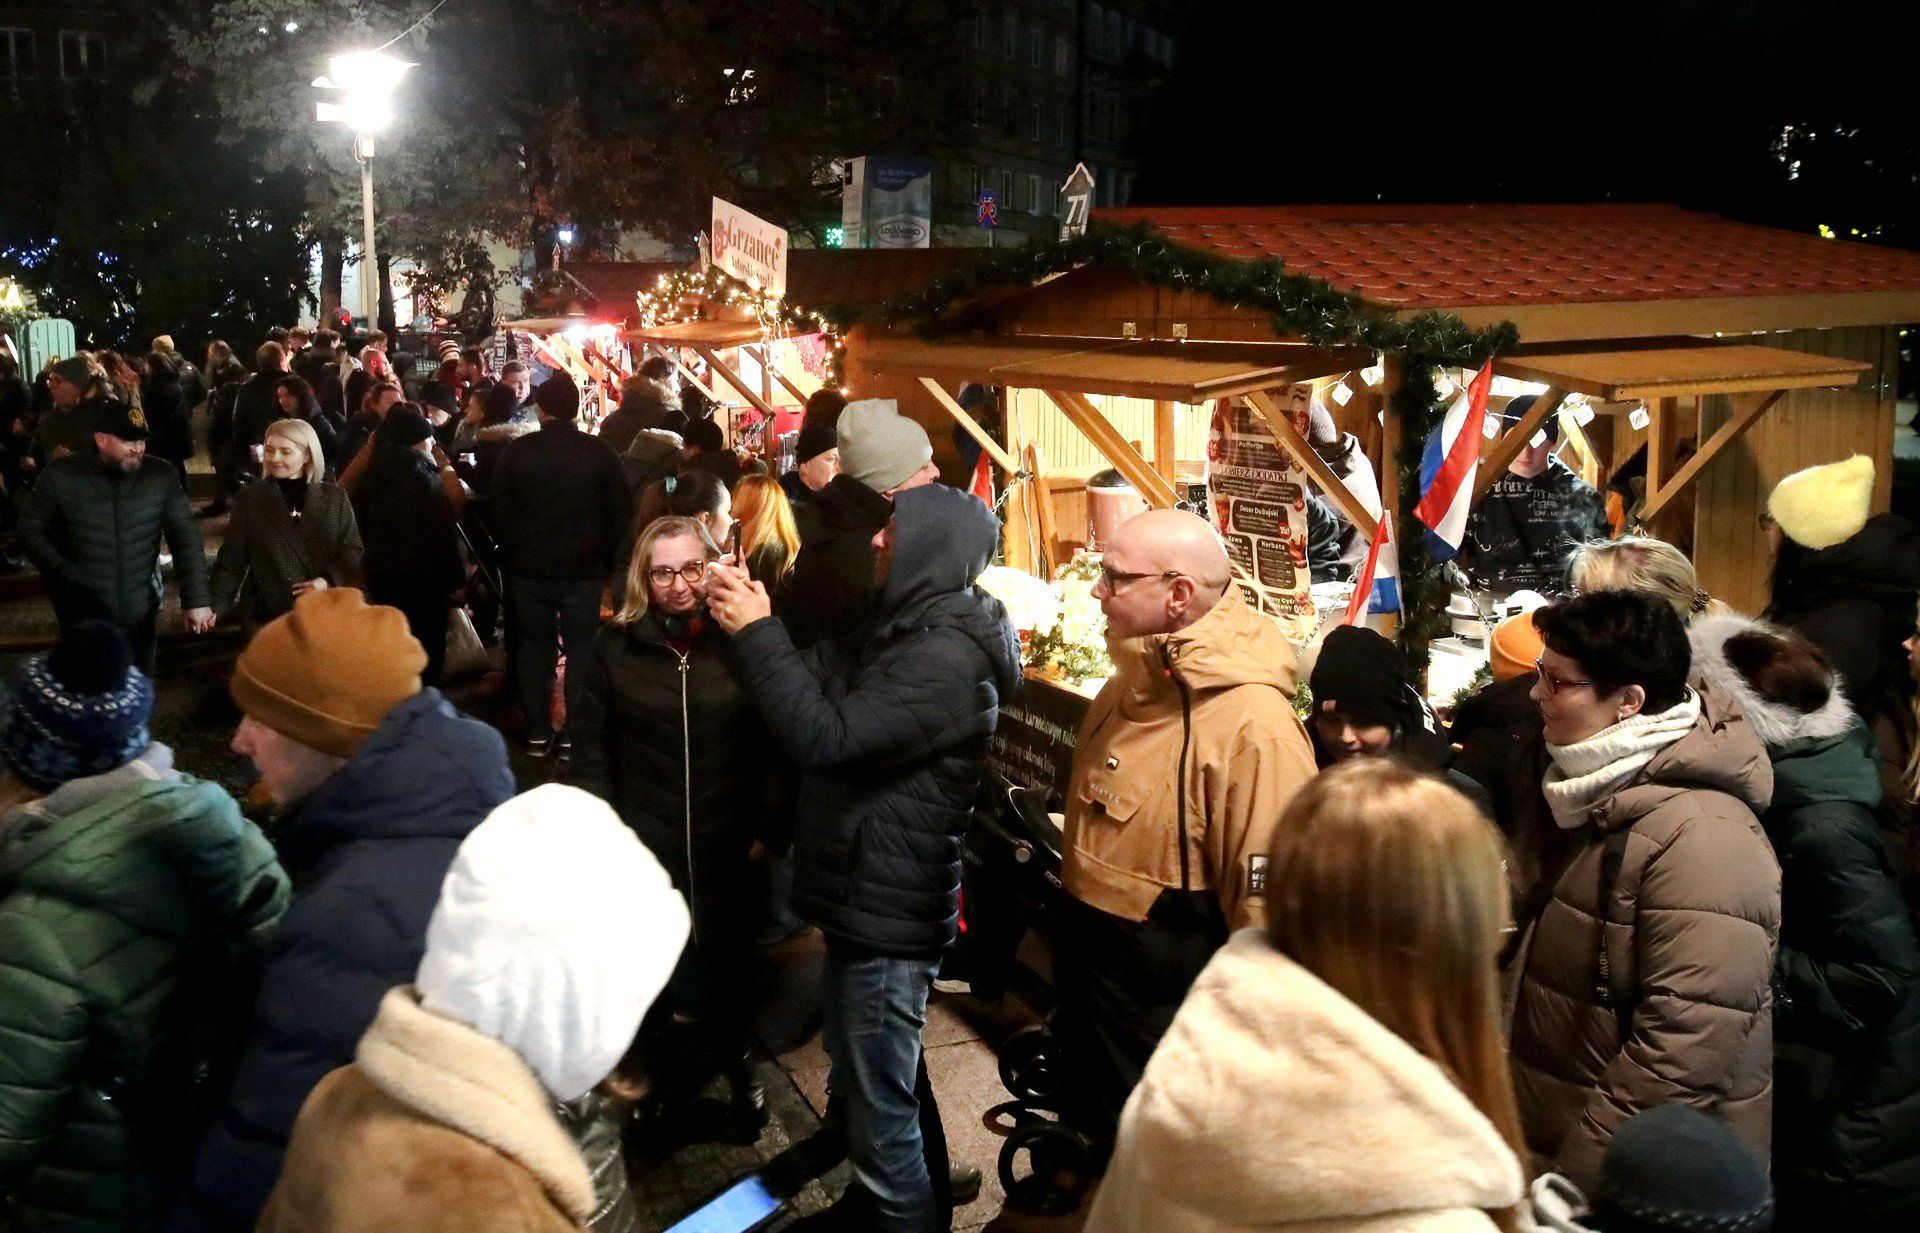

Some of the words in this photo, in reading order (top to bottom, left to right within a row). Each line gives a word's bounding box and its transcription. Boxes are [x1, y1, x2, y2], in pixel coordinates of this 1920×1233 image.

[1065, 193, 1087, 224] 77
[1252, 470, 1288, 482] DODATKI
[1486, 480, 1534, 493] uture
[1239, 504, 1255, 514] Deser
[1254, 507, 1279, 517] Dubajski
[1260, 540, 1286, 551] Herbata
